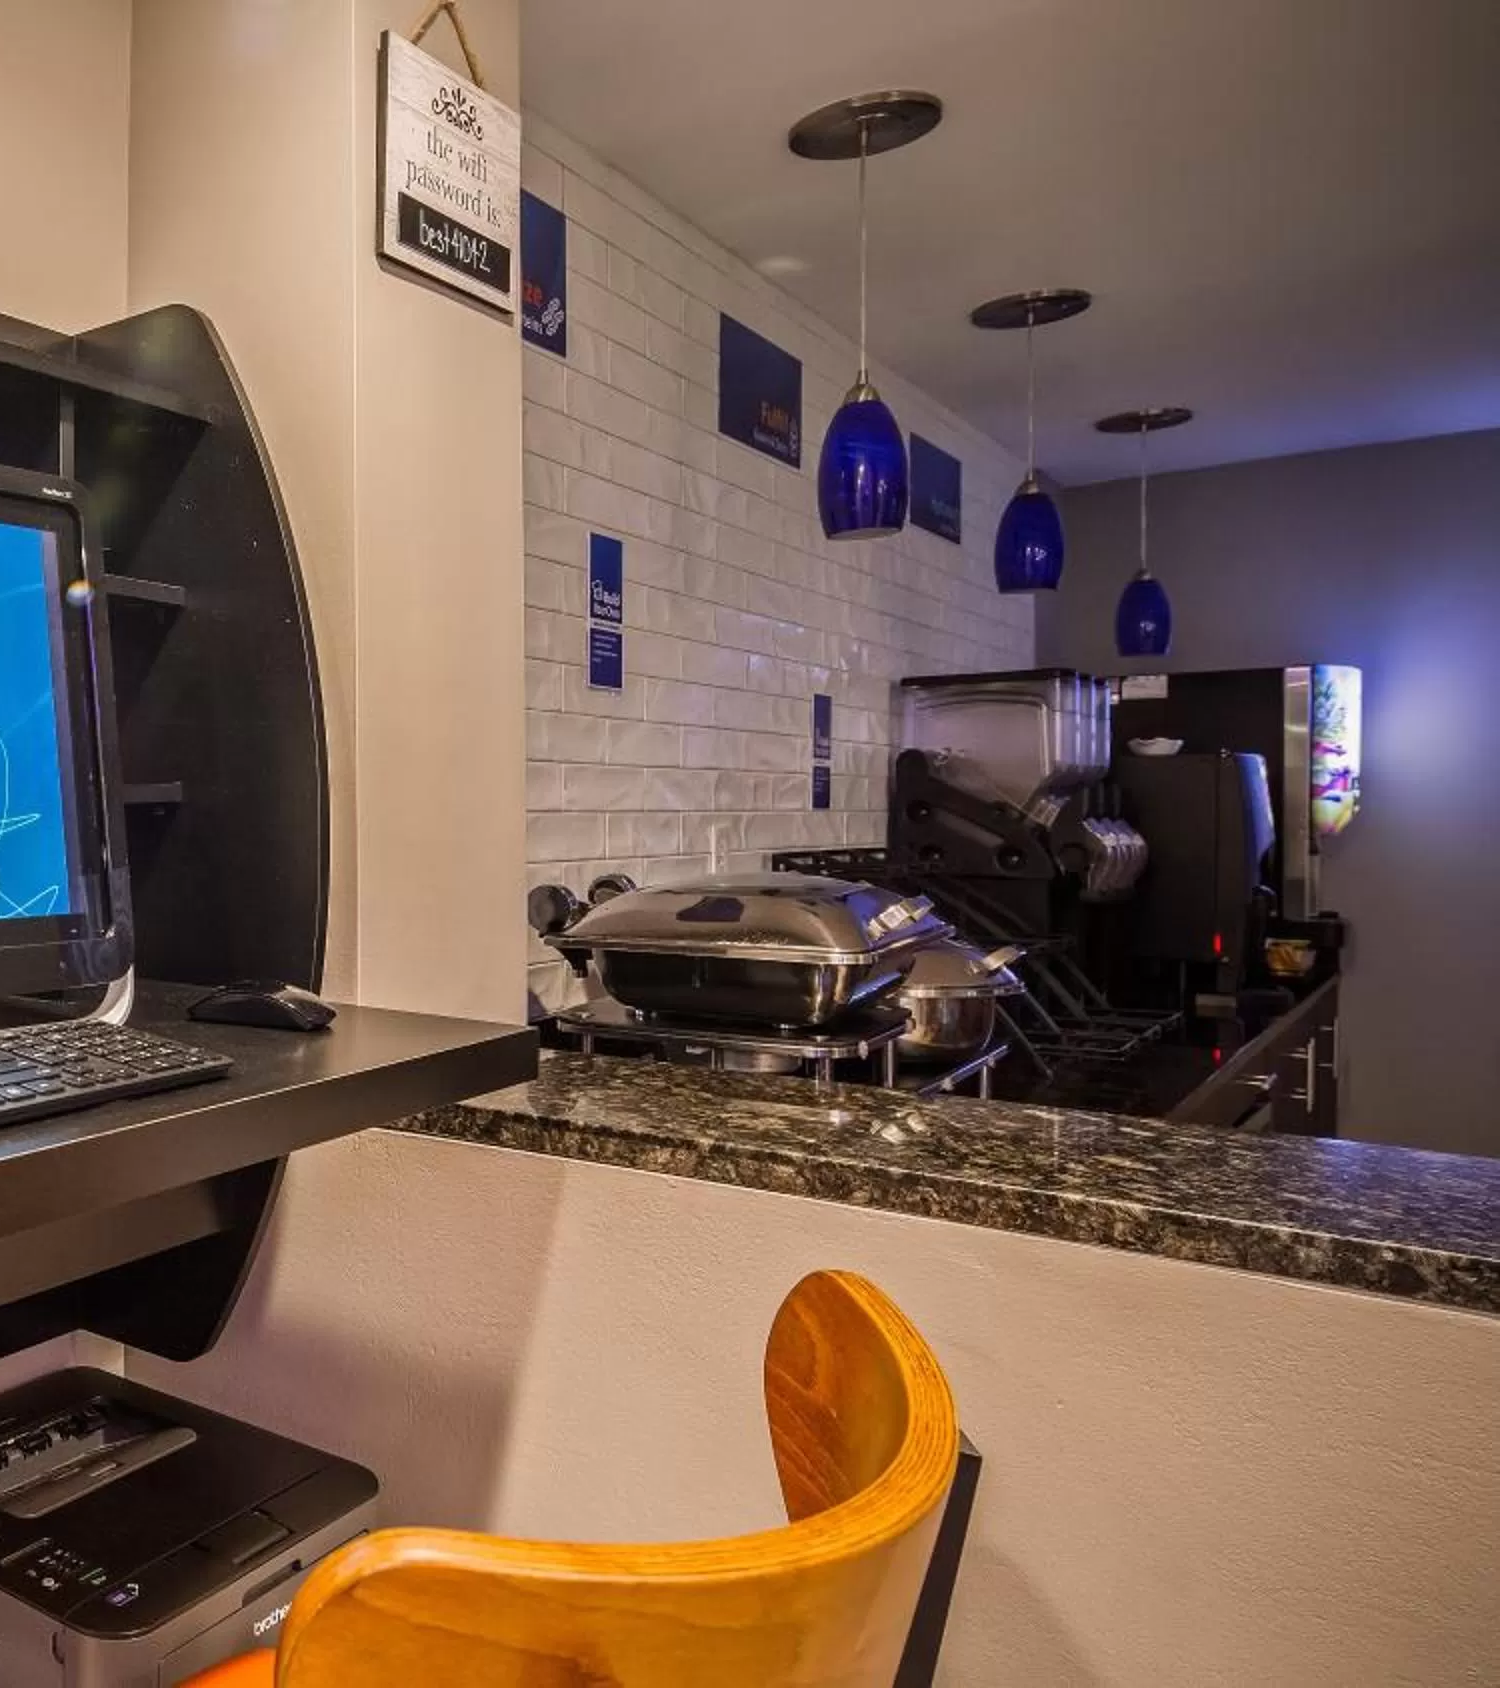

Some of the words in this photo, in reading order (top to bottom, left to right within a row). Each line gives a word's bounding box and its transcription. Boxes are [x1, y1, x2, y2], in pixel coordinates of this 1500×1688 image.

[427, 126, 453, 163] the
[457, 151, 488, 184] wifi
[405, 159, 481, 217] password
